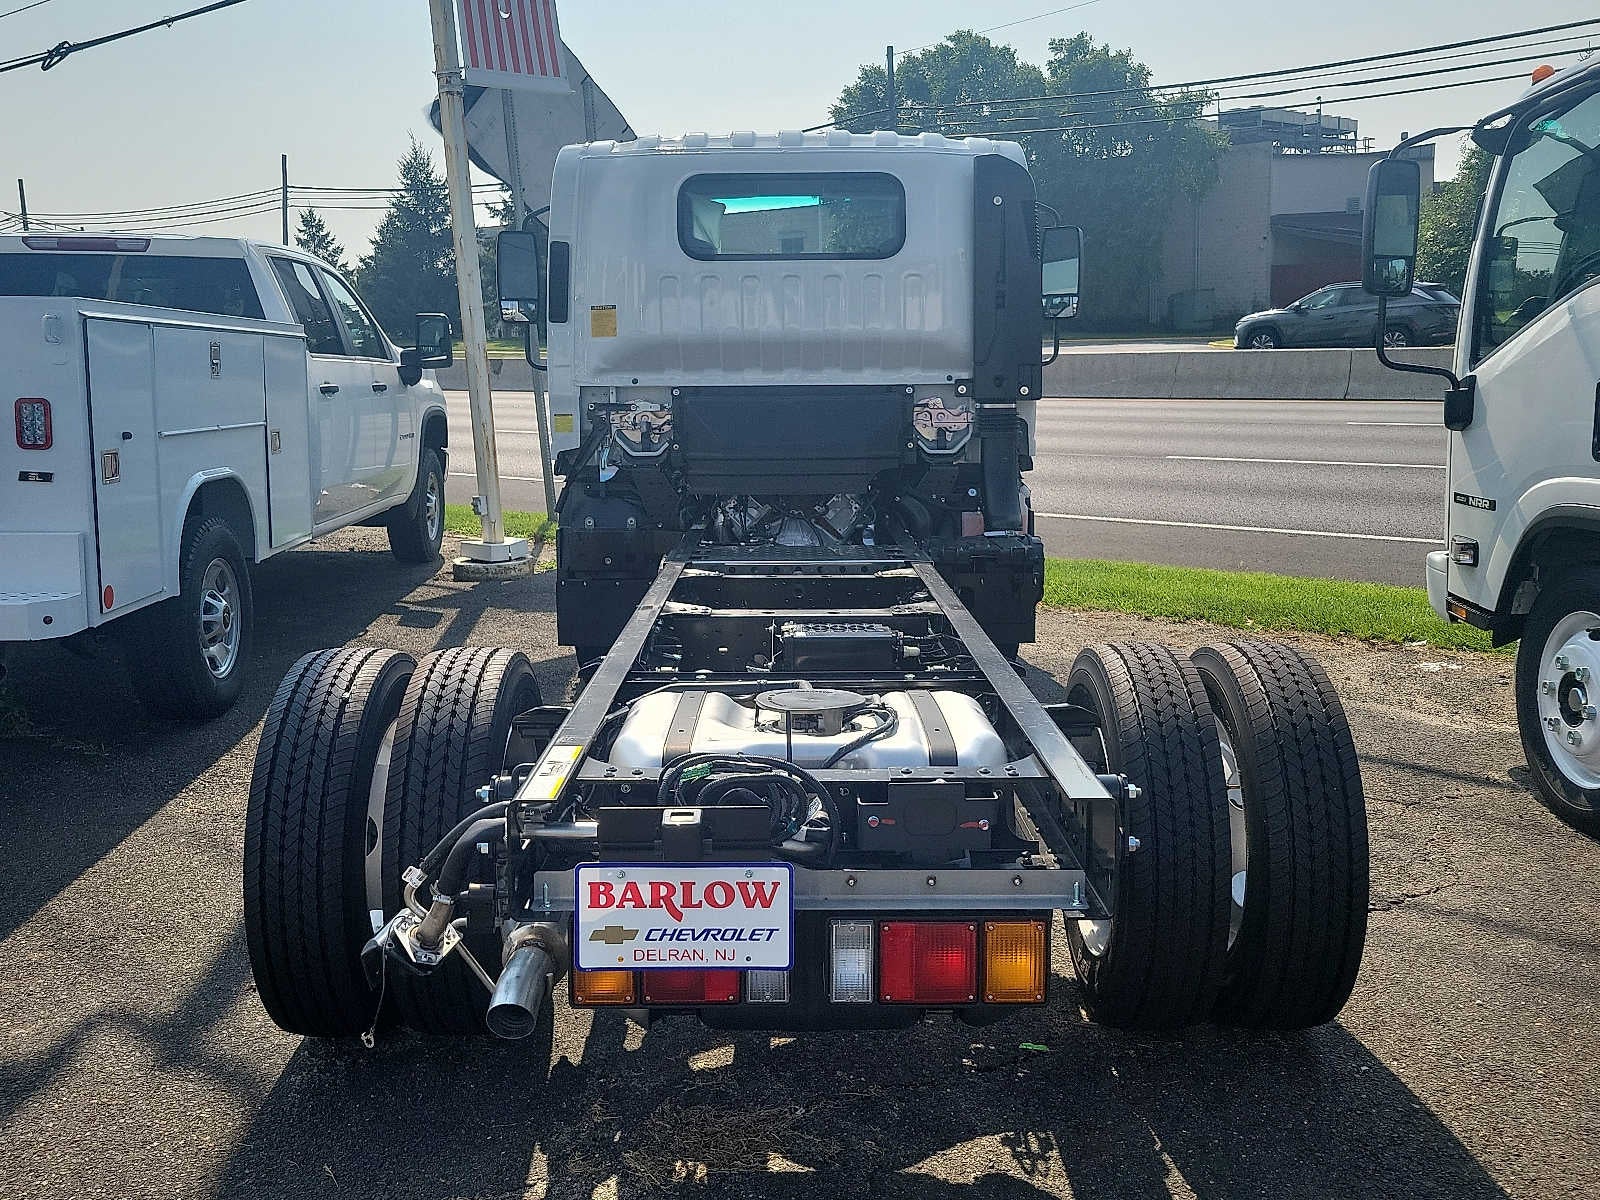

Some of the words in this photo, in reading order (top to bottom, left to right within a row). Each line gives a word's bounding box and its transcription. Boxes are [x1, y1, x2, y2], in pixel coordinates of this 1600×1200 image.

[1468, 496, 1490, 509] NRR
[587, 881, 781, 922] BARLOW
[644, 928, 780, 942] CHEVROLET
[633, 949, 709, 963] DELRAN,
[715, 949, 736, 962] NJ
